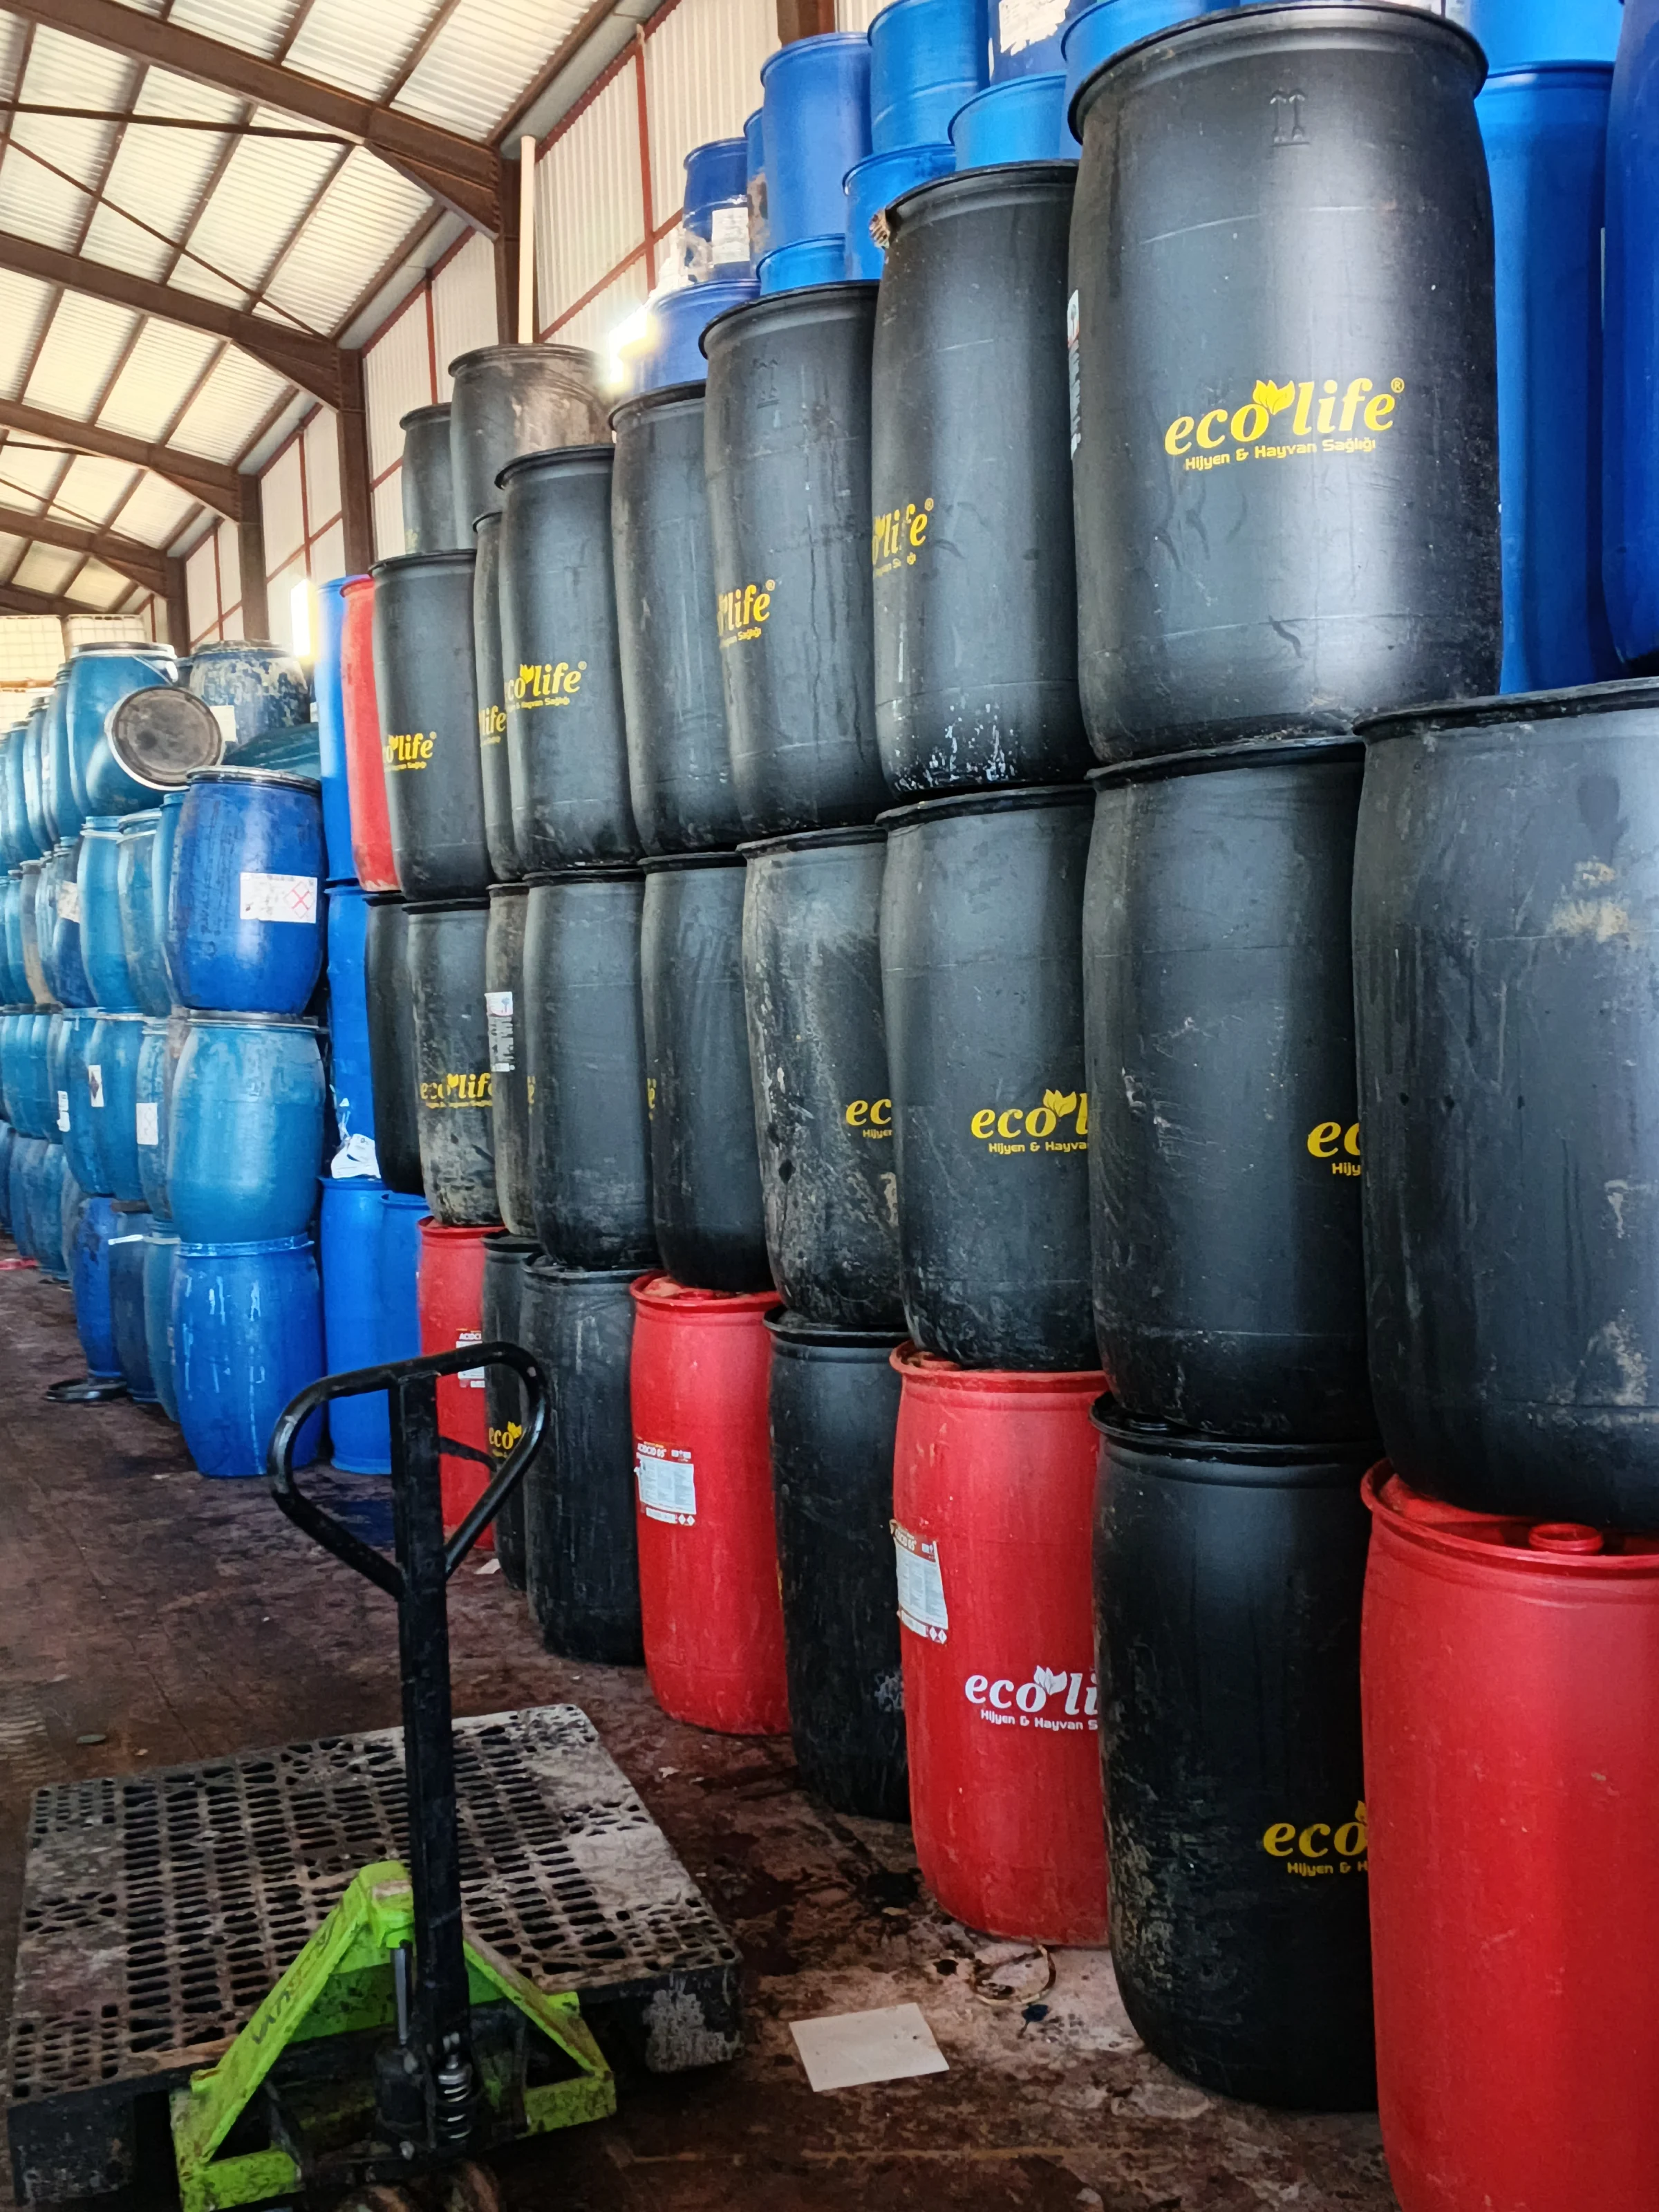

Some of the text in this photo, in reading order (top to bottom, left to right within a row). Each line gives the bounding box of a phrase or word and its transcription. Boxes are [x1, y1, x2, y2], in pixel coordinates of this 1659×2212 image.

[1185, 453, 1230, 471] Hijyen
[1236, 447, 1248, 461] &
[1254, 442, 1317, 459] Hayvan
[988, 1142, 1025, 1154] Hijyen
[1030, 1141, 1040, 1152] &
[980, 1709, 1015, 1725] Hijyen
[1020, 1715, 1030, 1726] &
[1034, 1717, 1084, 1732] Hayvan
[1287, 1862, 1334, 1877] Hijyen
[1339, 1861, 1351, 1873] &
